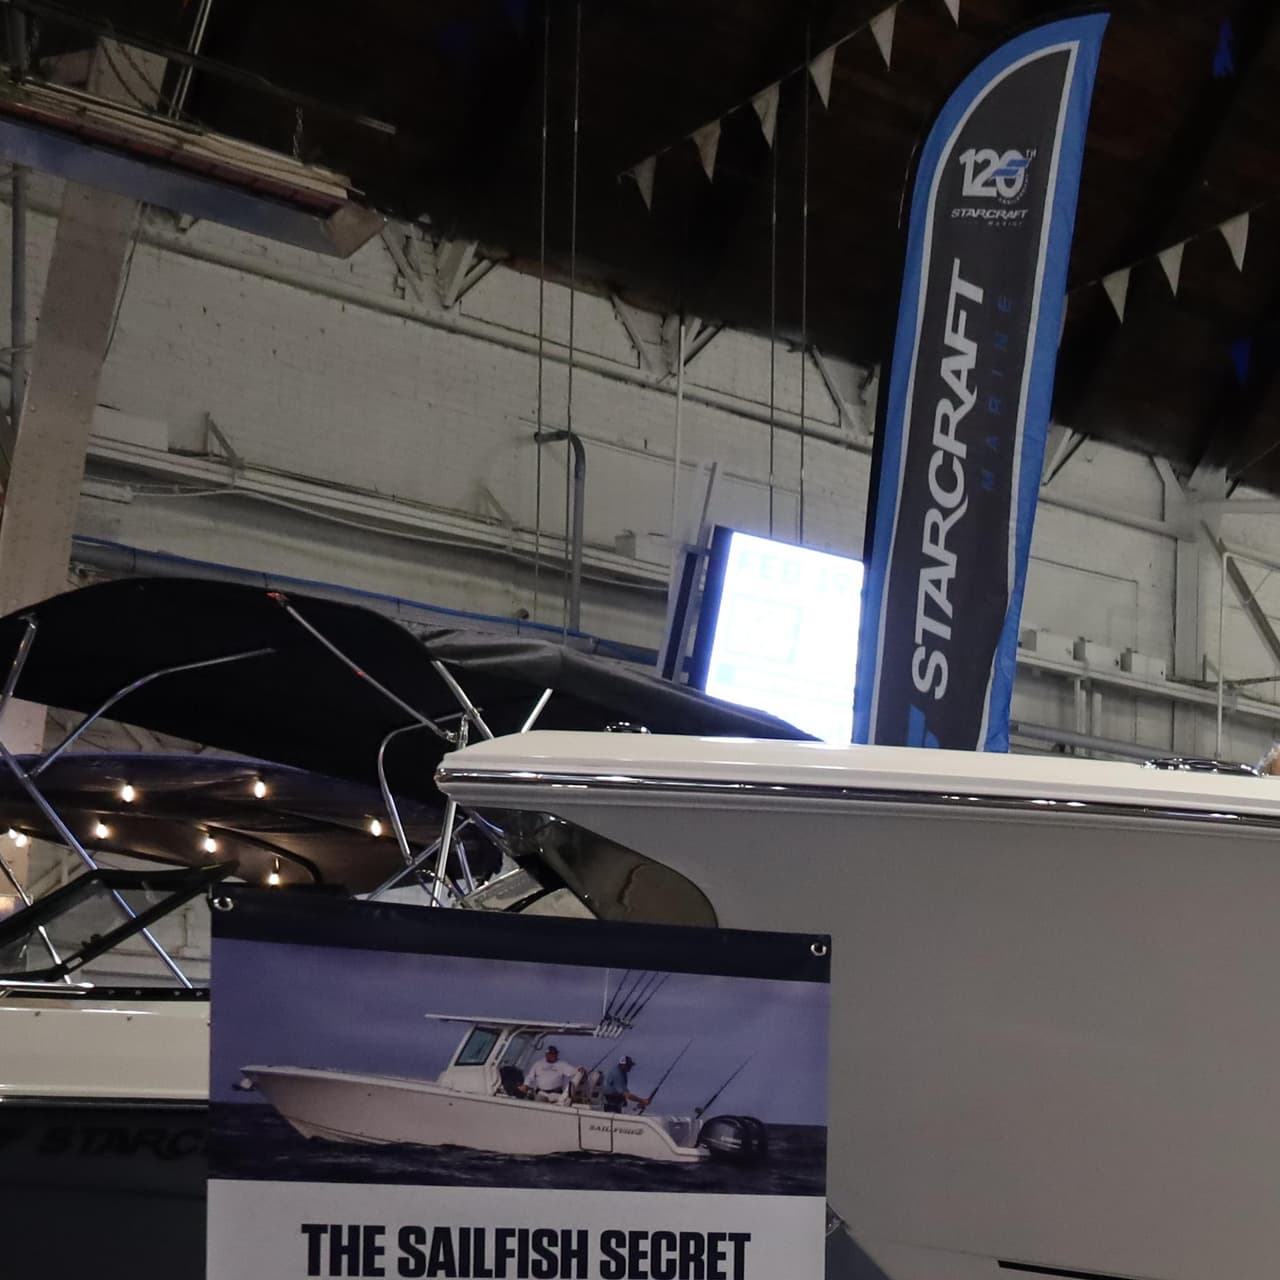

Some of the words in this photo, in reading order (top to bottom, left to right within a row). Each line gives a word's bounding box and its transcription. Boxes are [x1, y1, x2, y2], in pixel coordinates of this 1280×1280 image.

[959, 148, 1027, 198] 120
[951, 207, 1029, 220] STARCRAFT
[980, 294, 1010, 492] MARINE
[912, 256, 984, 699] STARCRAFT
[37, 1126, 207, 1160] STARC
[301, 1224, 385, 1277] THE
[398, 1226, 588, 1279] SAILFISH
[600, 1230, 751, 1280] SECRET
